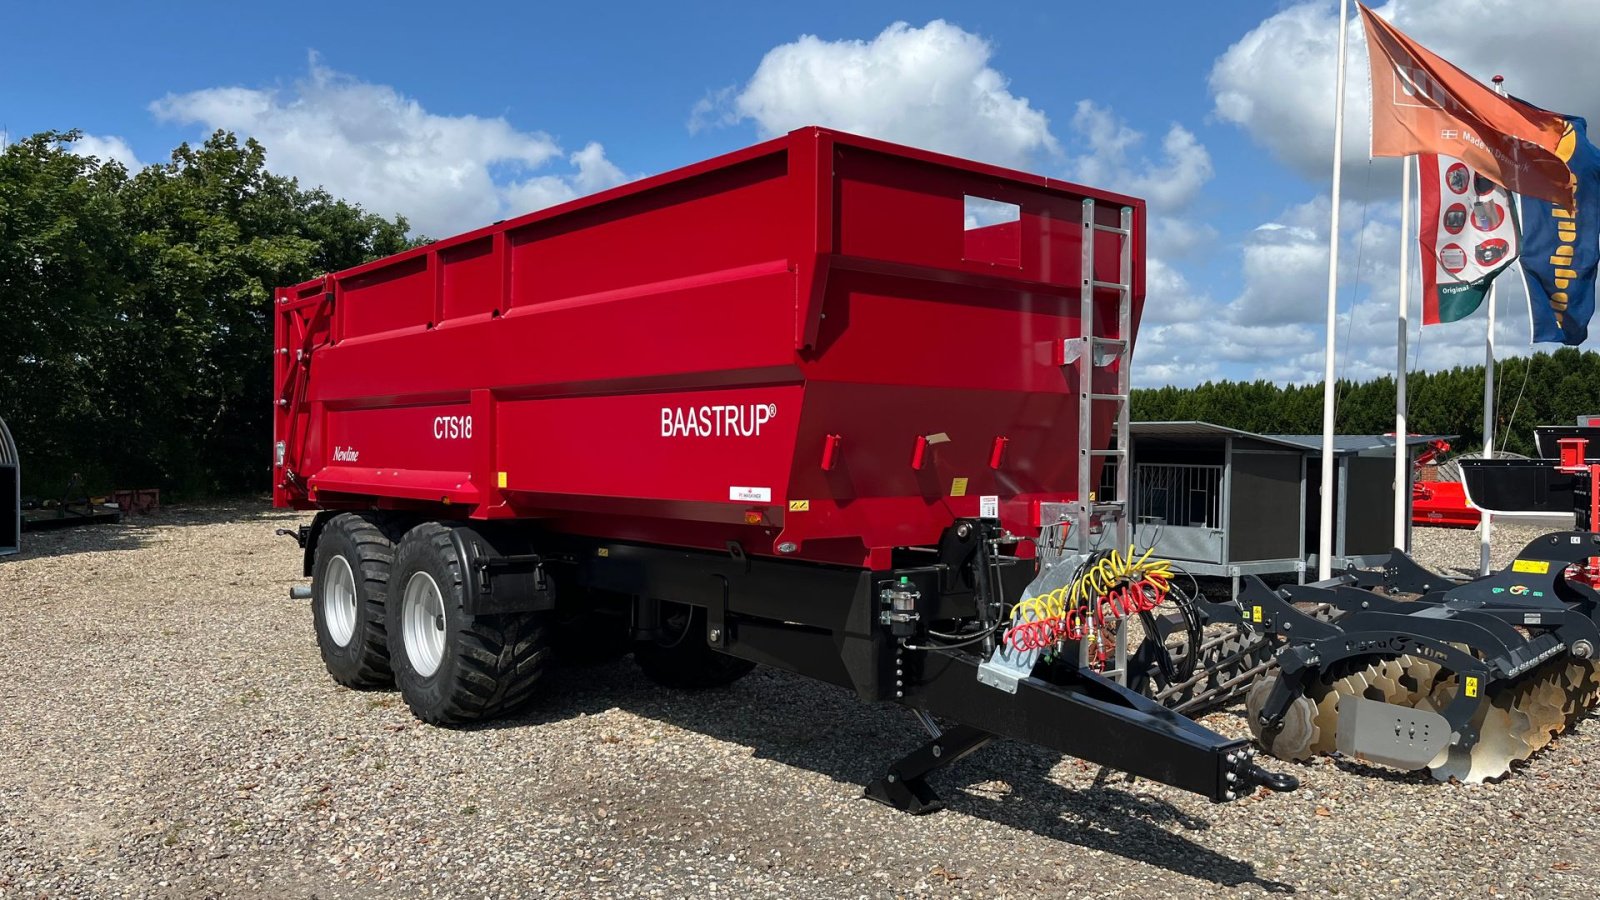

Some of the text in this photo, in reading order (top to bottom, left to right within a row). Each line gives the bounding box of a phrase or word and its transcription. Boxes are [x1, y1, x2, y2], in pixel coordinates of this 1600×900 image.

[1462, 131, 1485, 149] Made
[1442, 284, 1470, 295] Original
[433, 415, 473, 439] CTS18
[332, 446, 359, 462] Newline
